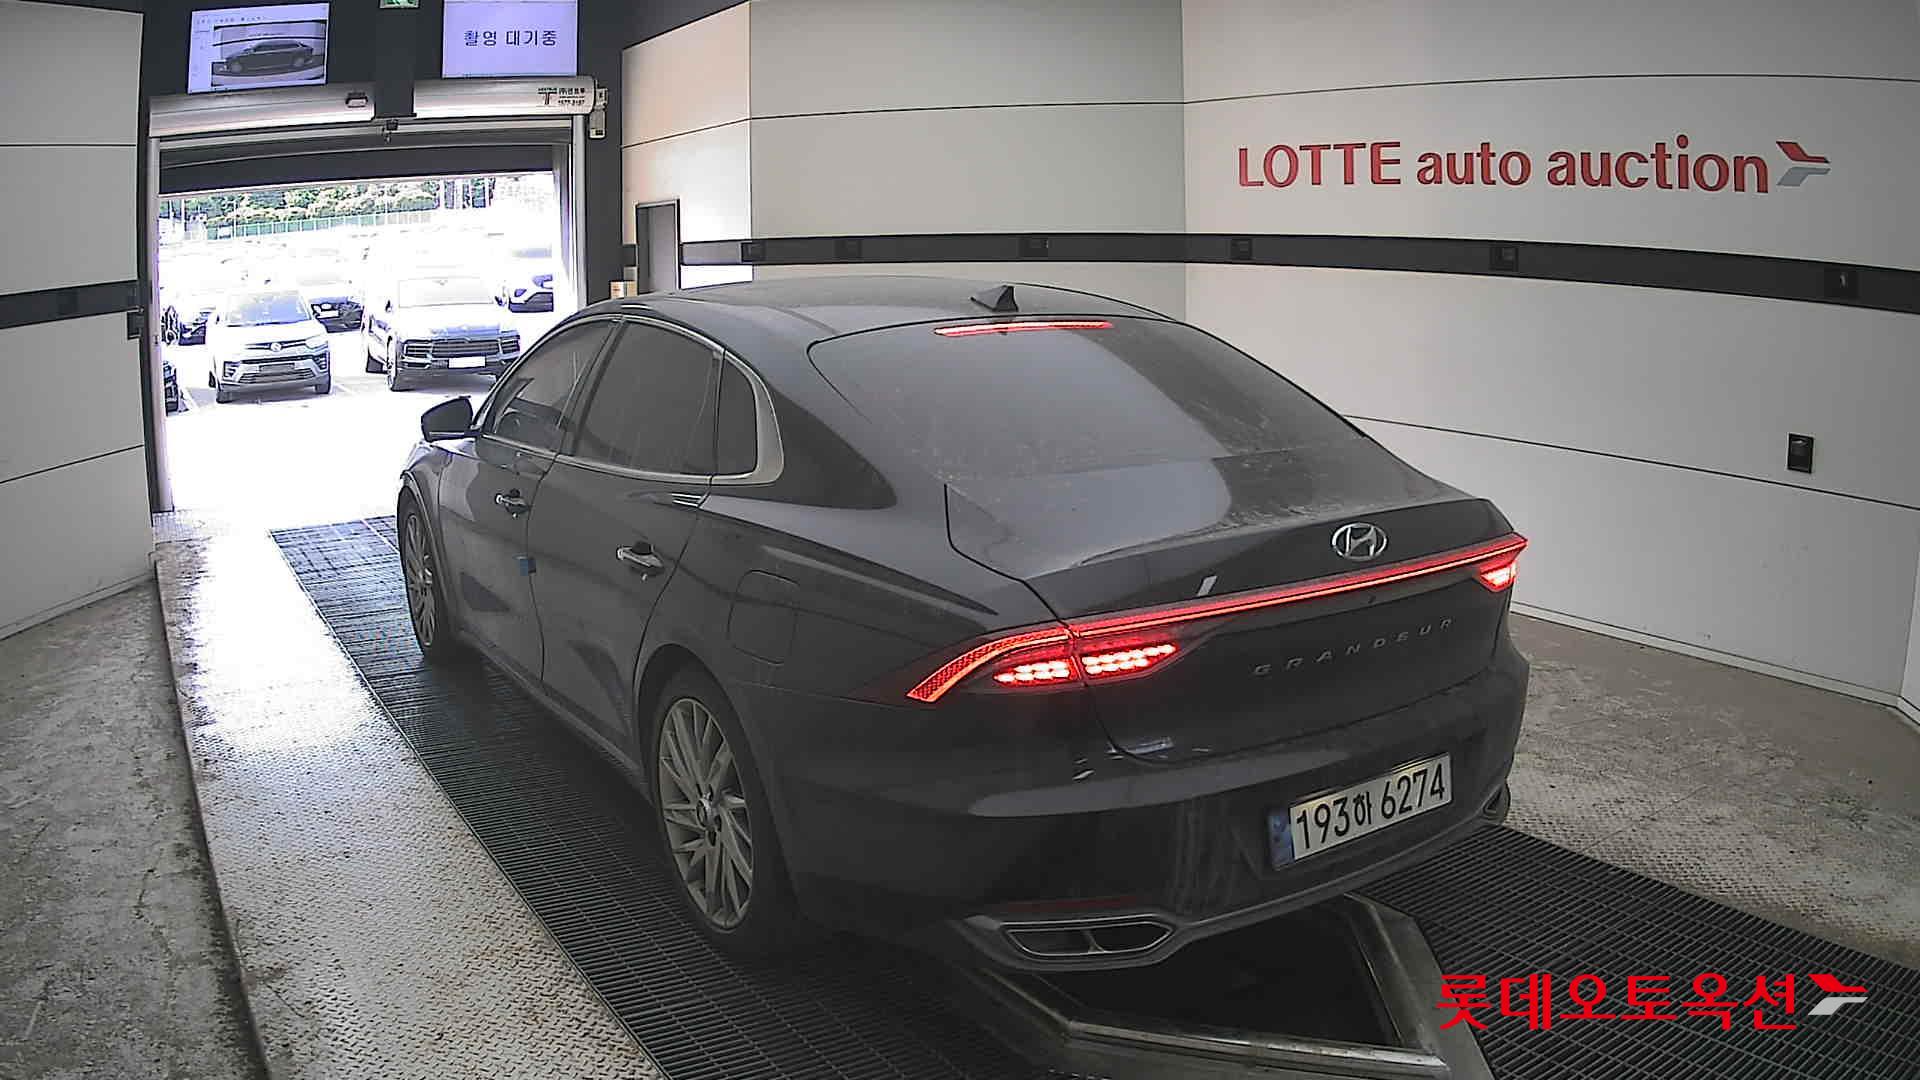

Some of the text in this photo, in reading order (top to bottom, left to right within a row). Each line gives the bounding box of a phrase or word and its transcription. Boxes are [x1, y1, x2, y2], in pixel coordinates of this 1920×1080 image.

[464, 30, 556, 46] 촬영 대기중
[1238, 134, 1769, 194] LOTTE auto auction
[1253, 618, 1452, 675] GRANDEUR
[1296, 763, 1445, 850] 193하 6274
